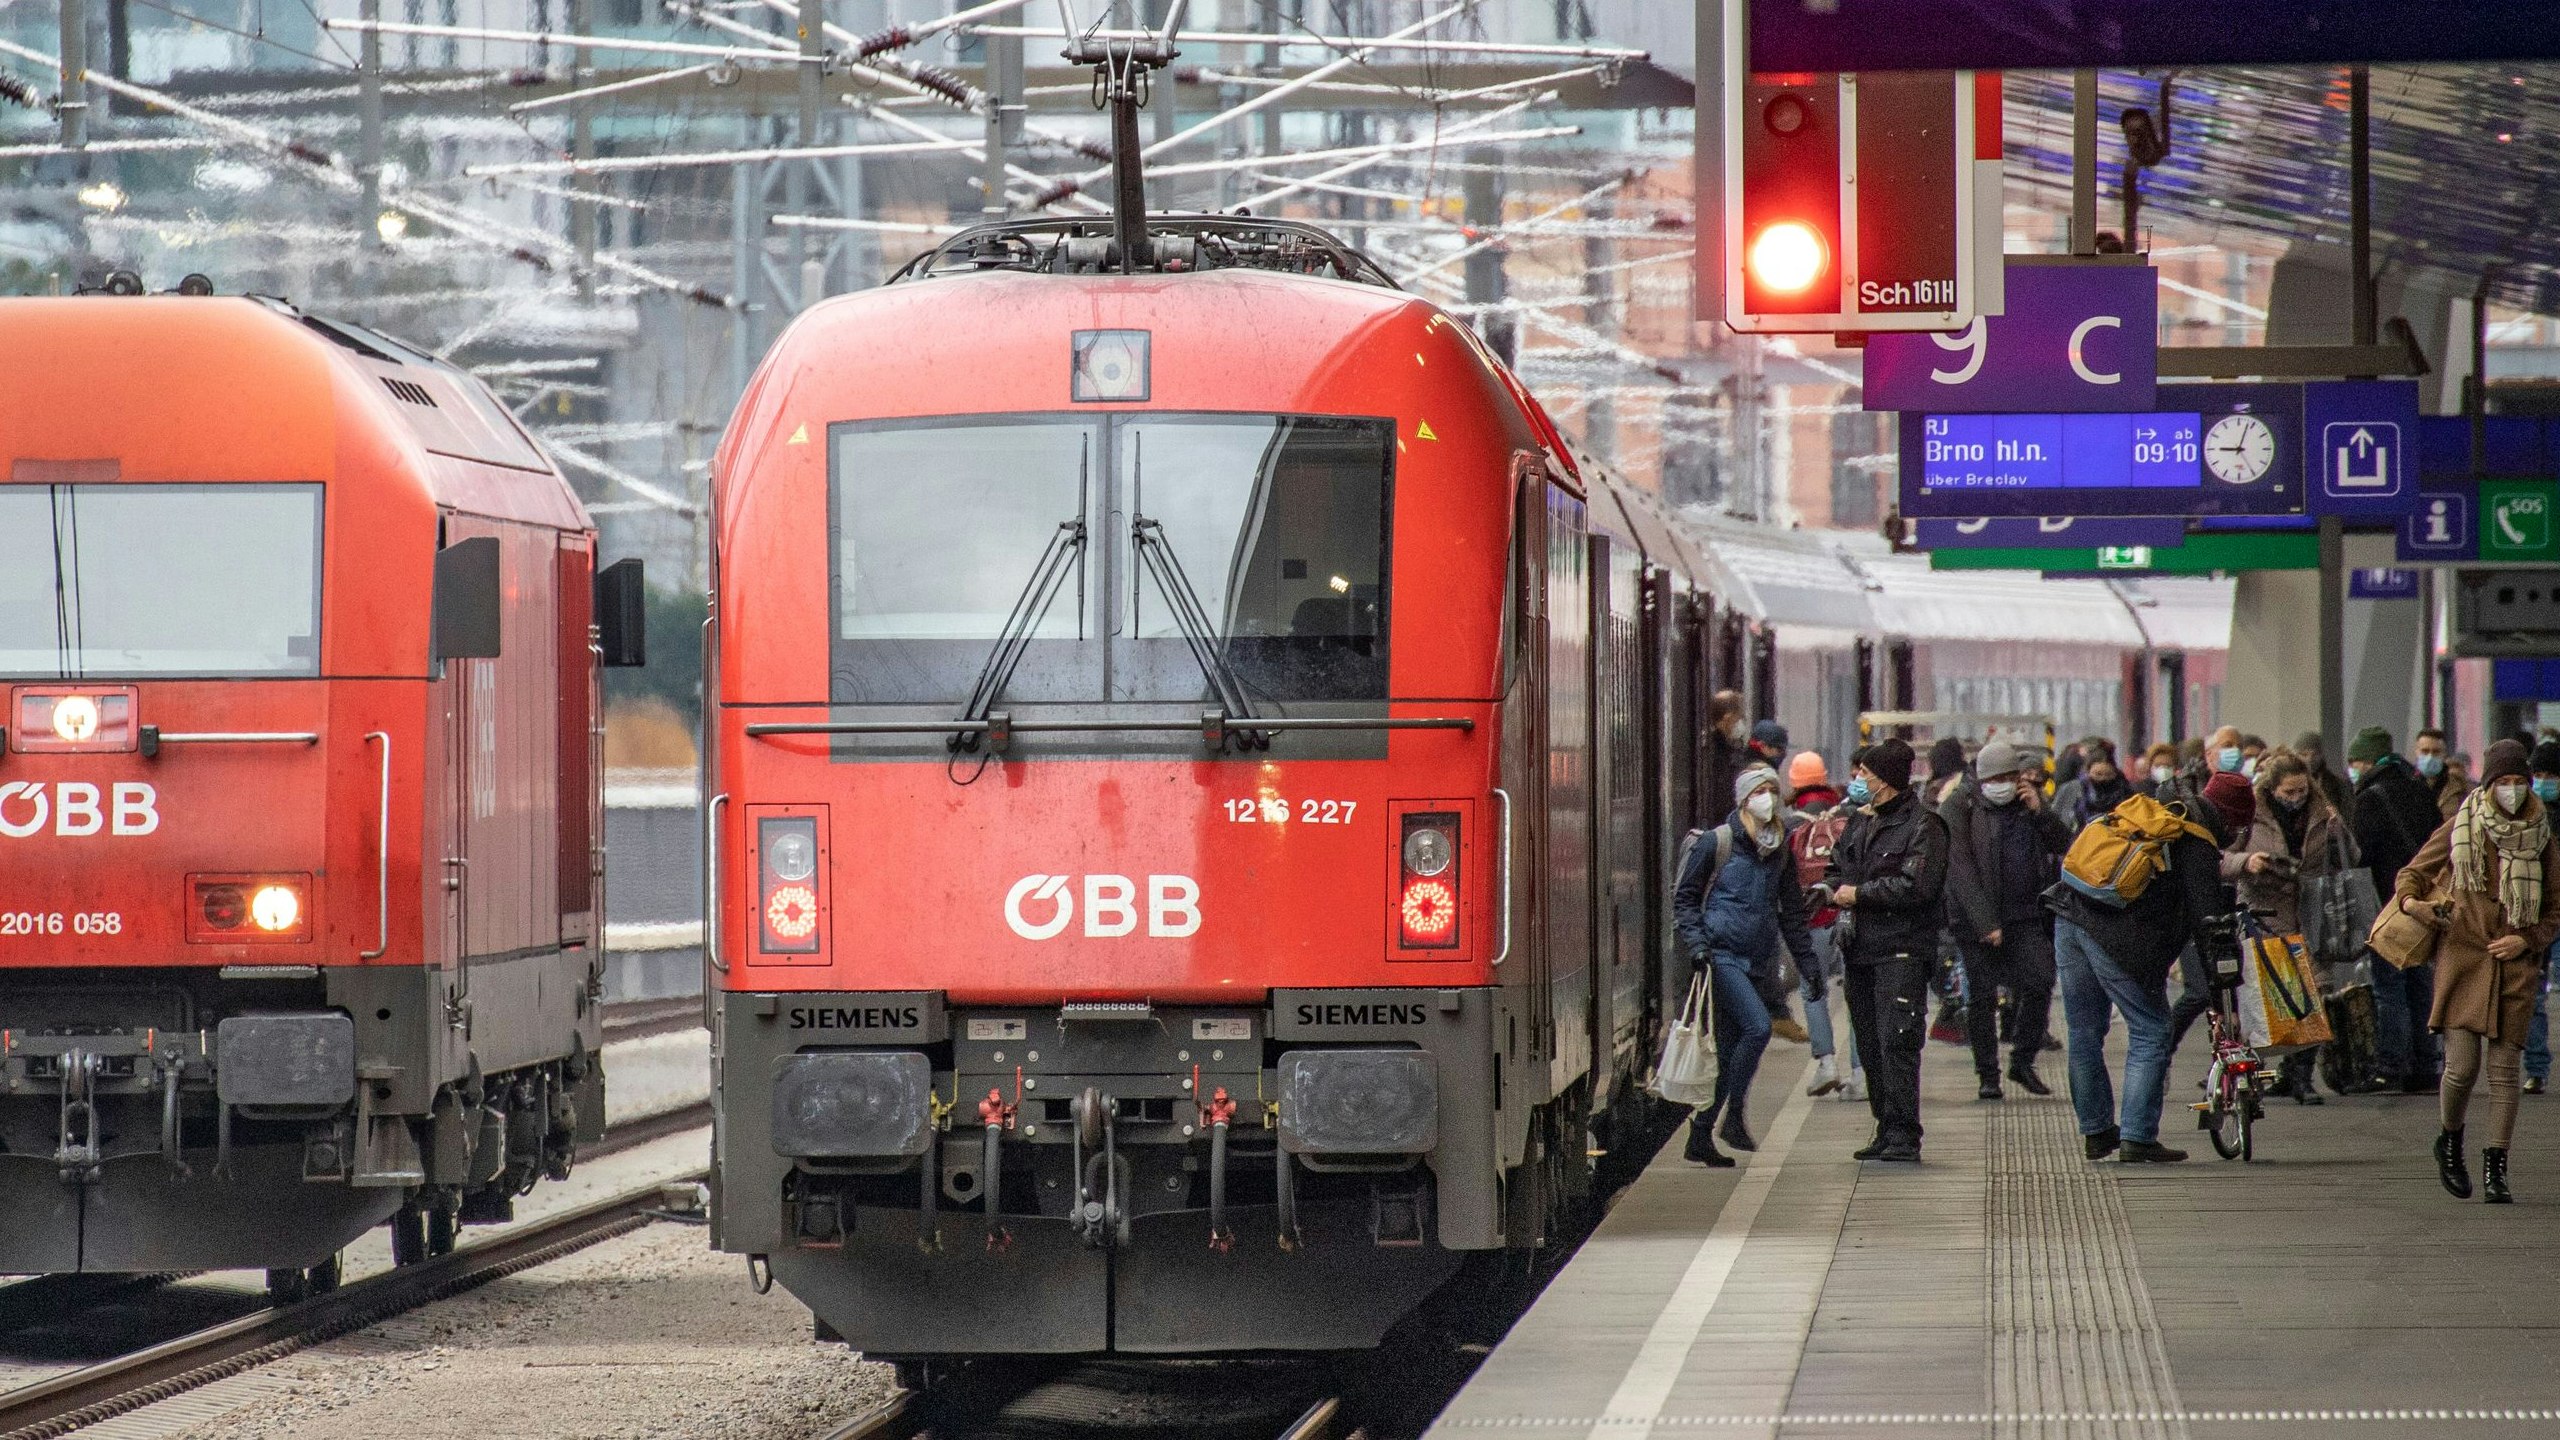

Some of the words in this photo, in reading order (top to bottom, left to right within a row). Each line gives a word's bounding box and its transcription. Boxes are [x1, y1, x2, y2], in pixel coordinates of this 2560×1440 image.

[2068, 315, 2121, 385] C
[1925, 418, 1949, 436] RJ
[2174, 428, 2194, 440] ab
[1925, 440, 1985, 462] Brno
[1996, 439, 2048, 462] hl.n.
[2134, 442, 2198, 463] 09:10
[1925, 474, 1961, 486] über
[2510, 498, 2543, 515] SOS
[1223, 798, 1290, 823] 1216
[1301, 799, 1357, 825] 227
[1004, 873, 1202, 940] ÖBB
[0, 912, 64, 935] 2016
[73, 912, 122, 935] 058
[790, 1007, 919, 1029] SIEMENS
[1297, 1004, 1427, 1025] SIEMENS
